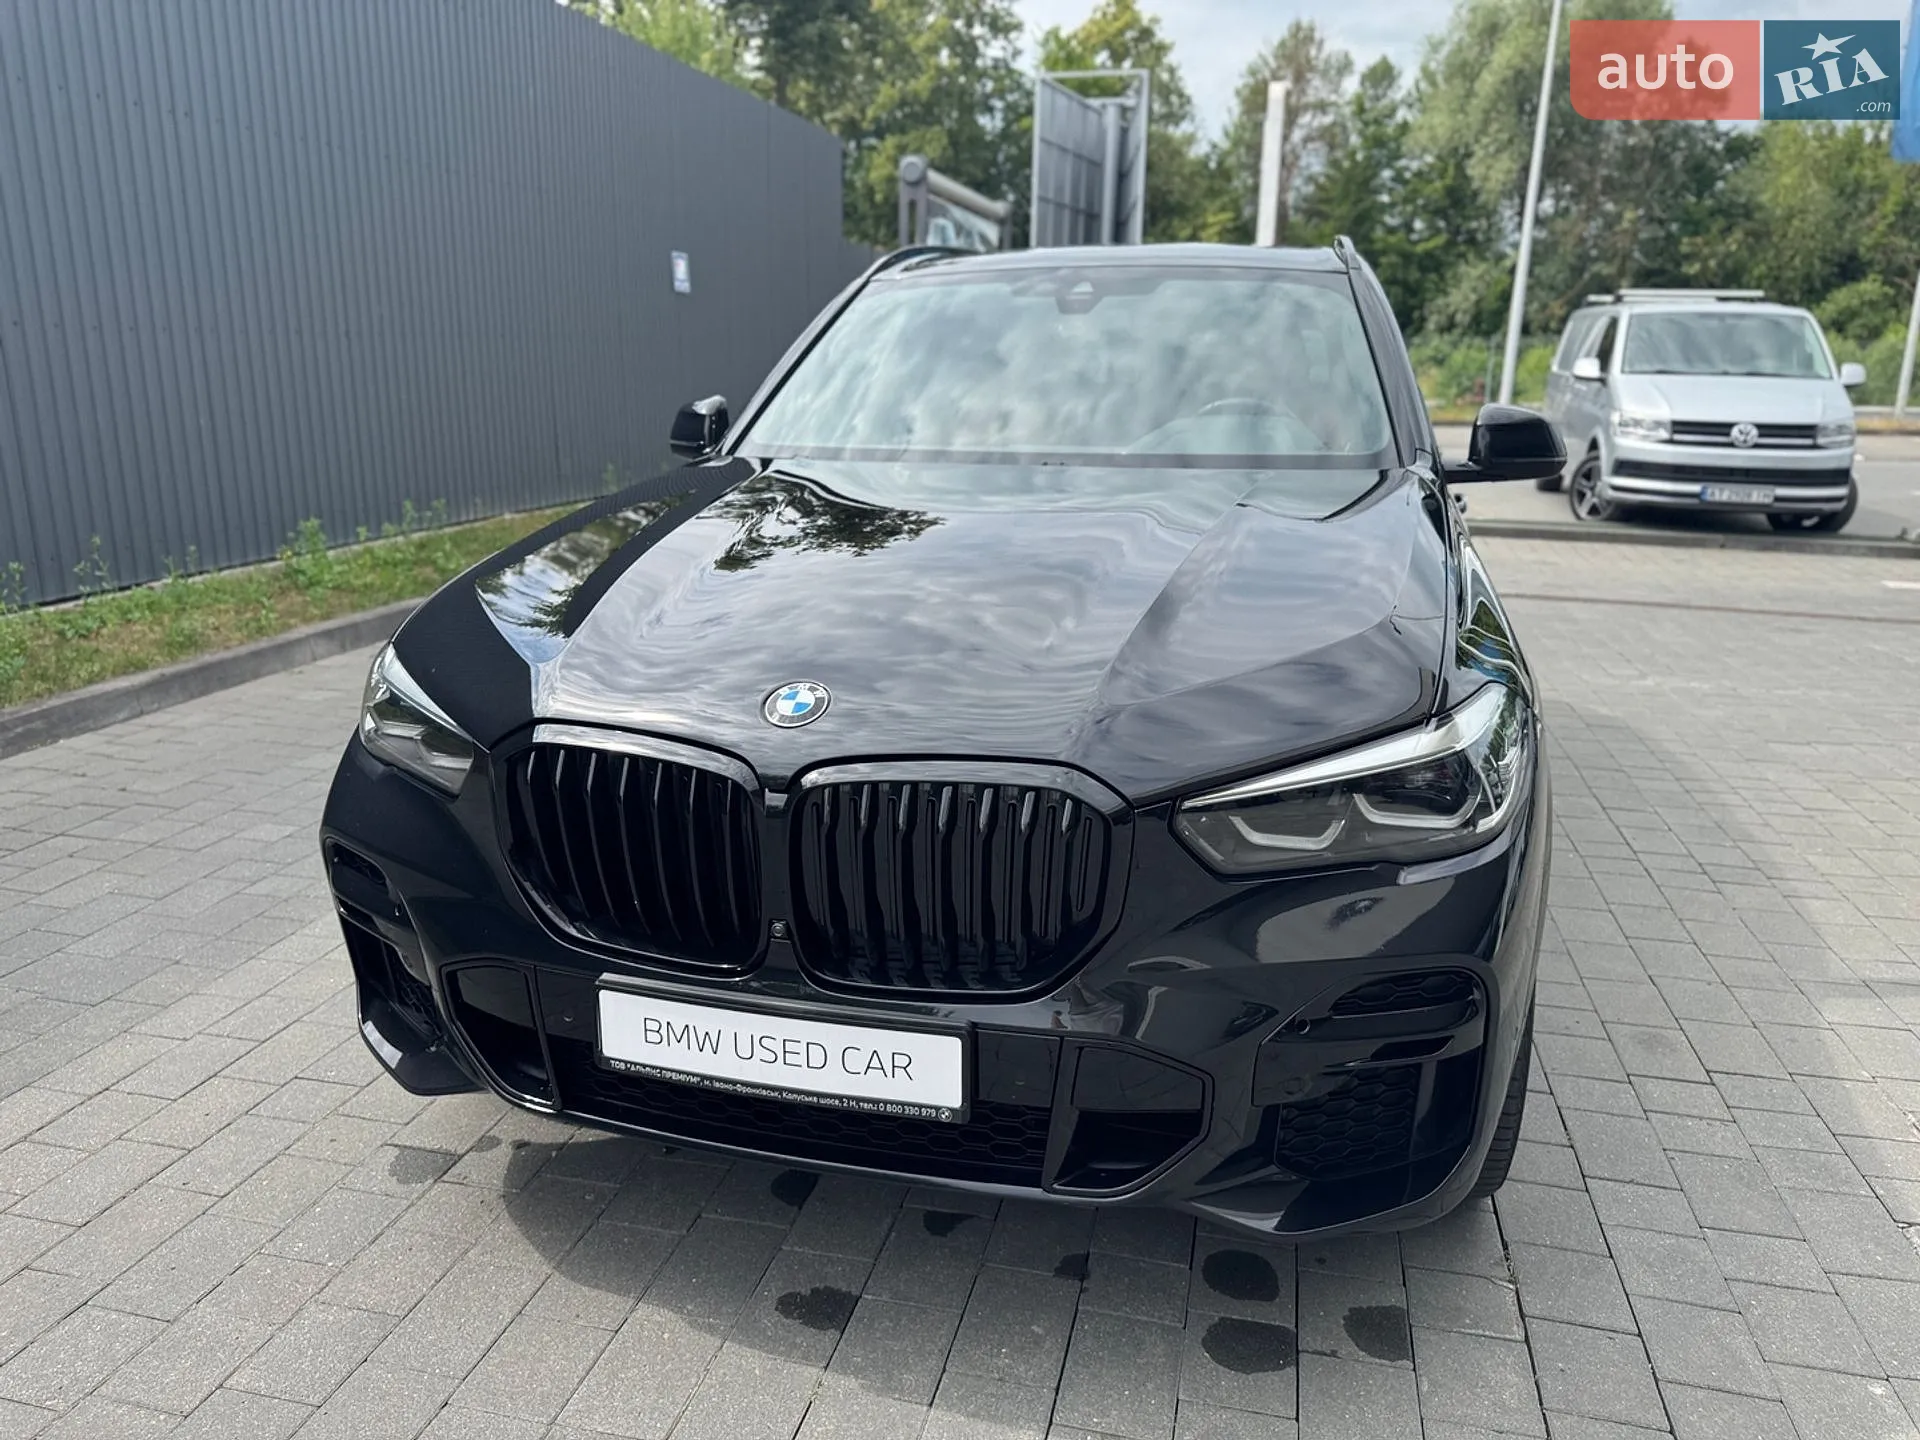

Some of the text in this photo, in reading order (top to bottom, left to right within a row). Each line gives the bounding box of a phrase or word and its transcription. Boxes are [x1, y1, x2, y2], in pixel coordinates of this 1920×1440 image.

[643, 1017, 914, 1081] BMW USED CAR
[842, 1098, 849, 1106] 2
[878, 1102, 886, 1112] 0
[886, 1103, 903, 1113] 800
[903, 1105, 920, 1115] 330
[920, 1106, 936, 1118] 979
